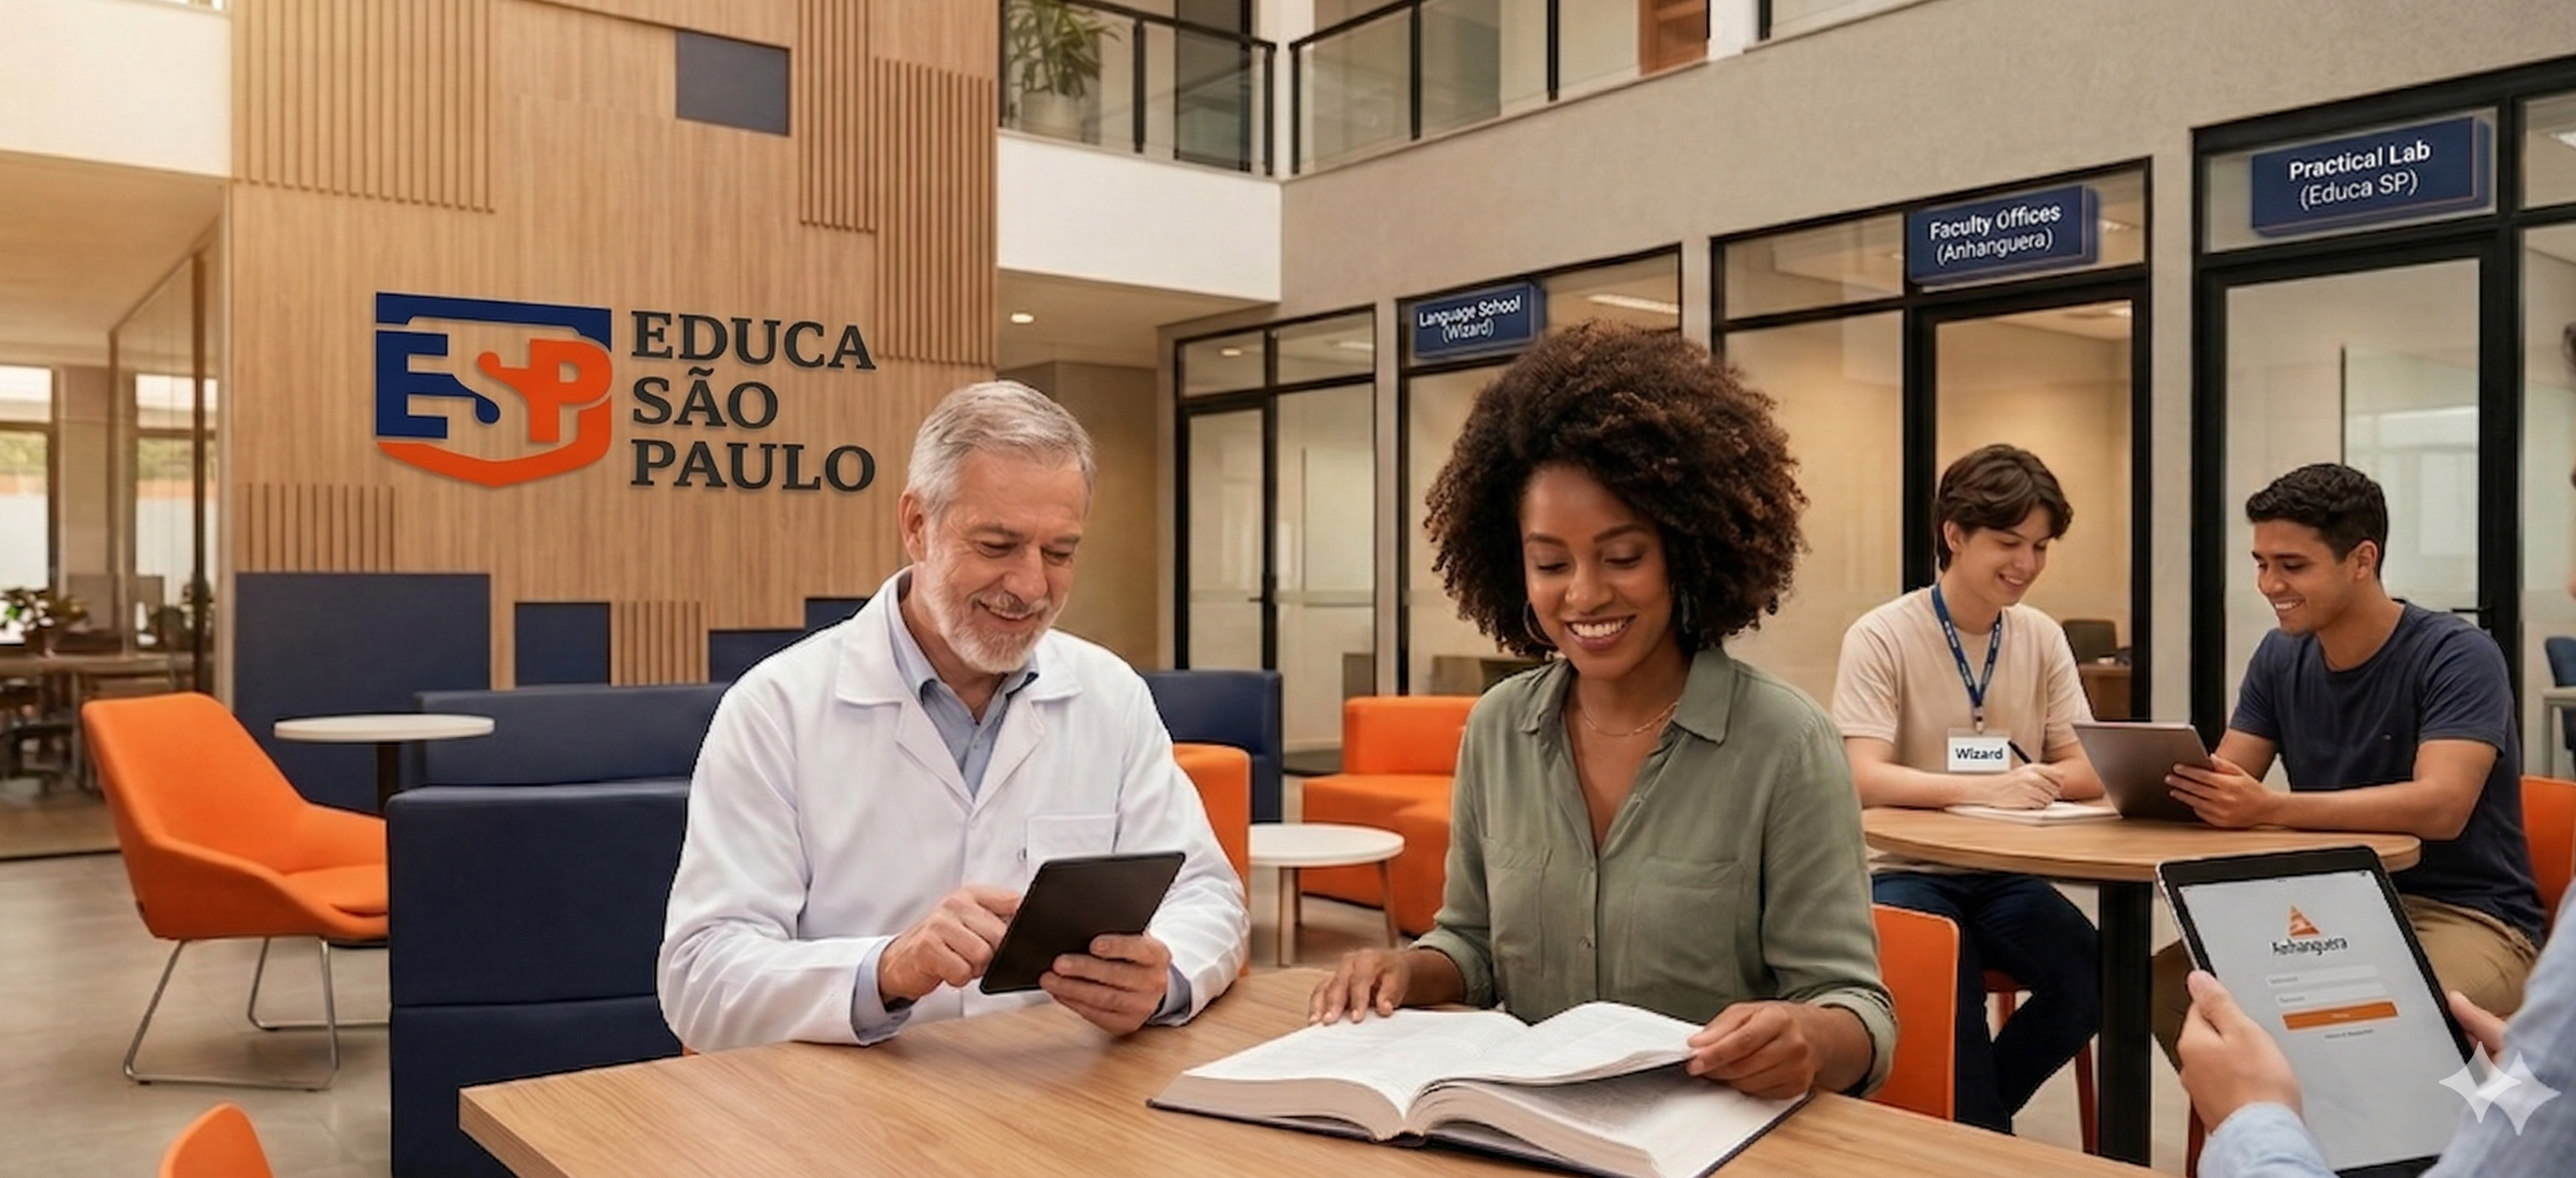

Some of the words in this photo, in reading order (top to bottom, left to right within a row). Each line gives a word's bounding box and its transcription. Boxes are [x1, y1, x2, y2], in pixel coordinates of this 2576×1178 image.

[2288, 146, 2383, 181] Practical
[2389, 140, 2431, 165] Lab
[2300, 181, 2373, 211] (Educa
[2379, 170, 2419, 197] SP)
[1930, 214, 1992, 241] Faculty
[1996, 205, 2062, 230] Offices
[1936, 228, 2054, 267] (Anhanguera)
[1418, 305, 1477, 328] Language
[1477, 294, 1522, 318] School
[1441, 318, 1495, 343] (Wizard)
[630, 310, 878, 372] EDUCA
[632, 366, 780, 430] SÃO
[630, 438, 877, 493] PAULO
[1955, 747, 2004, 760] Wizard
